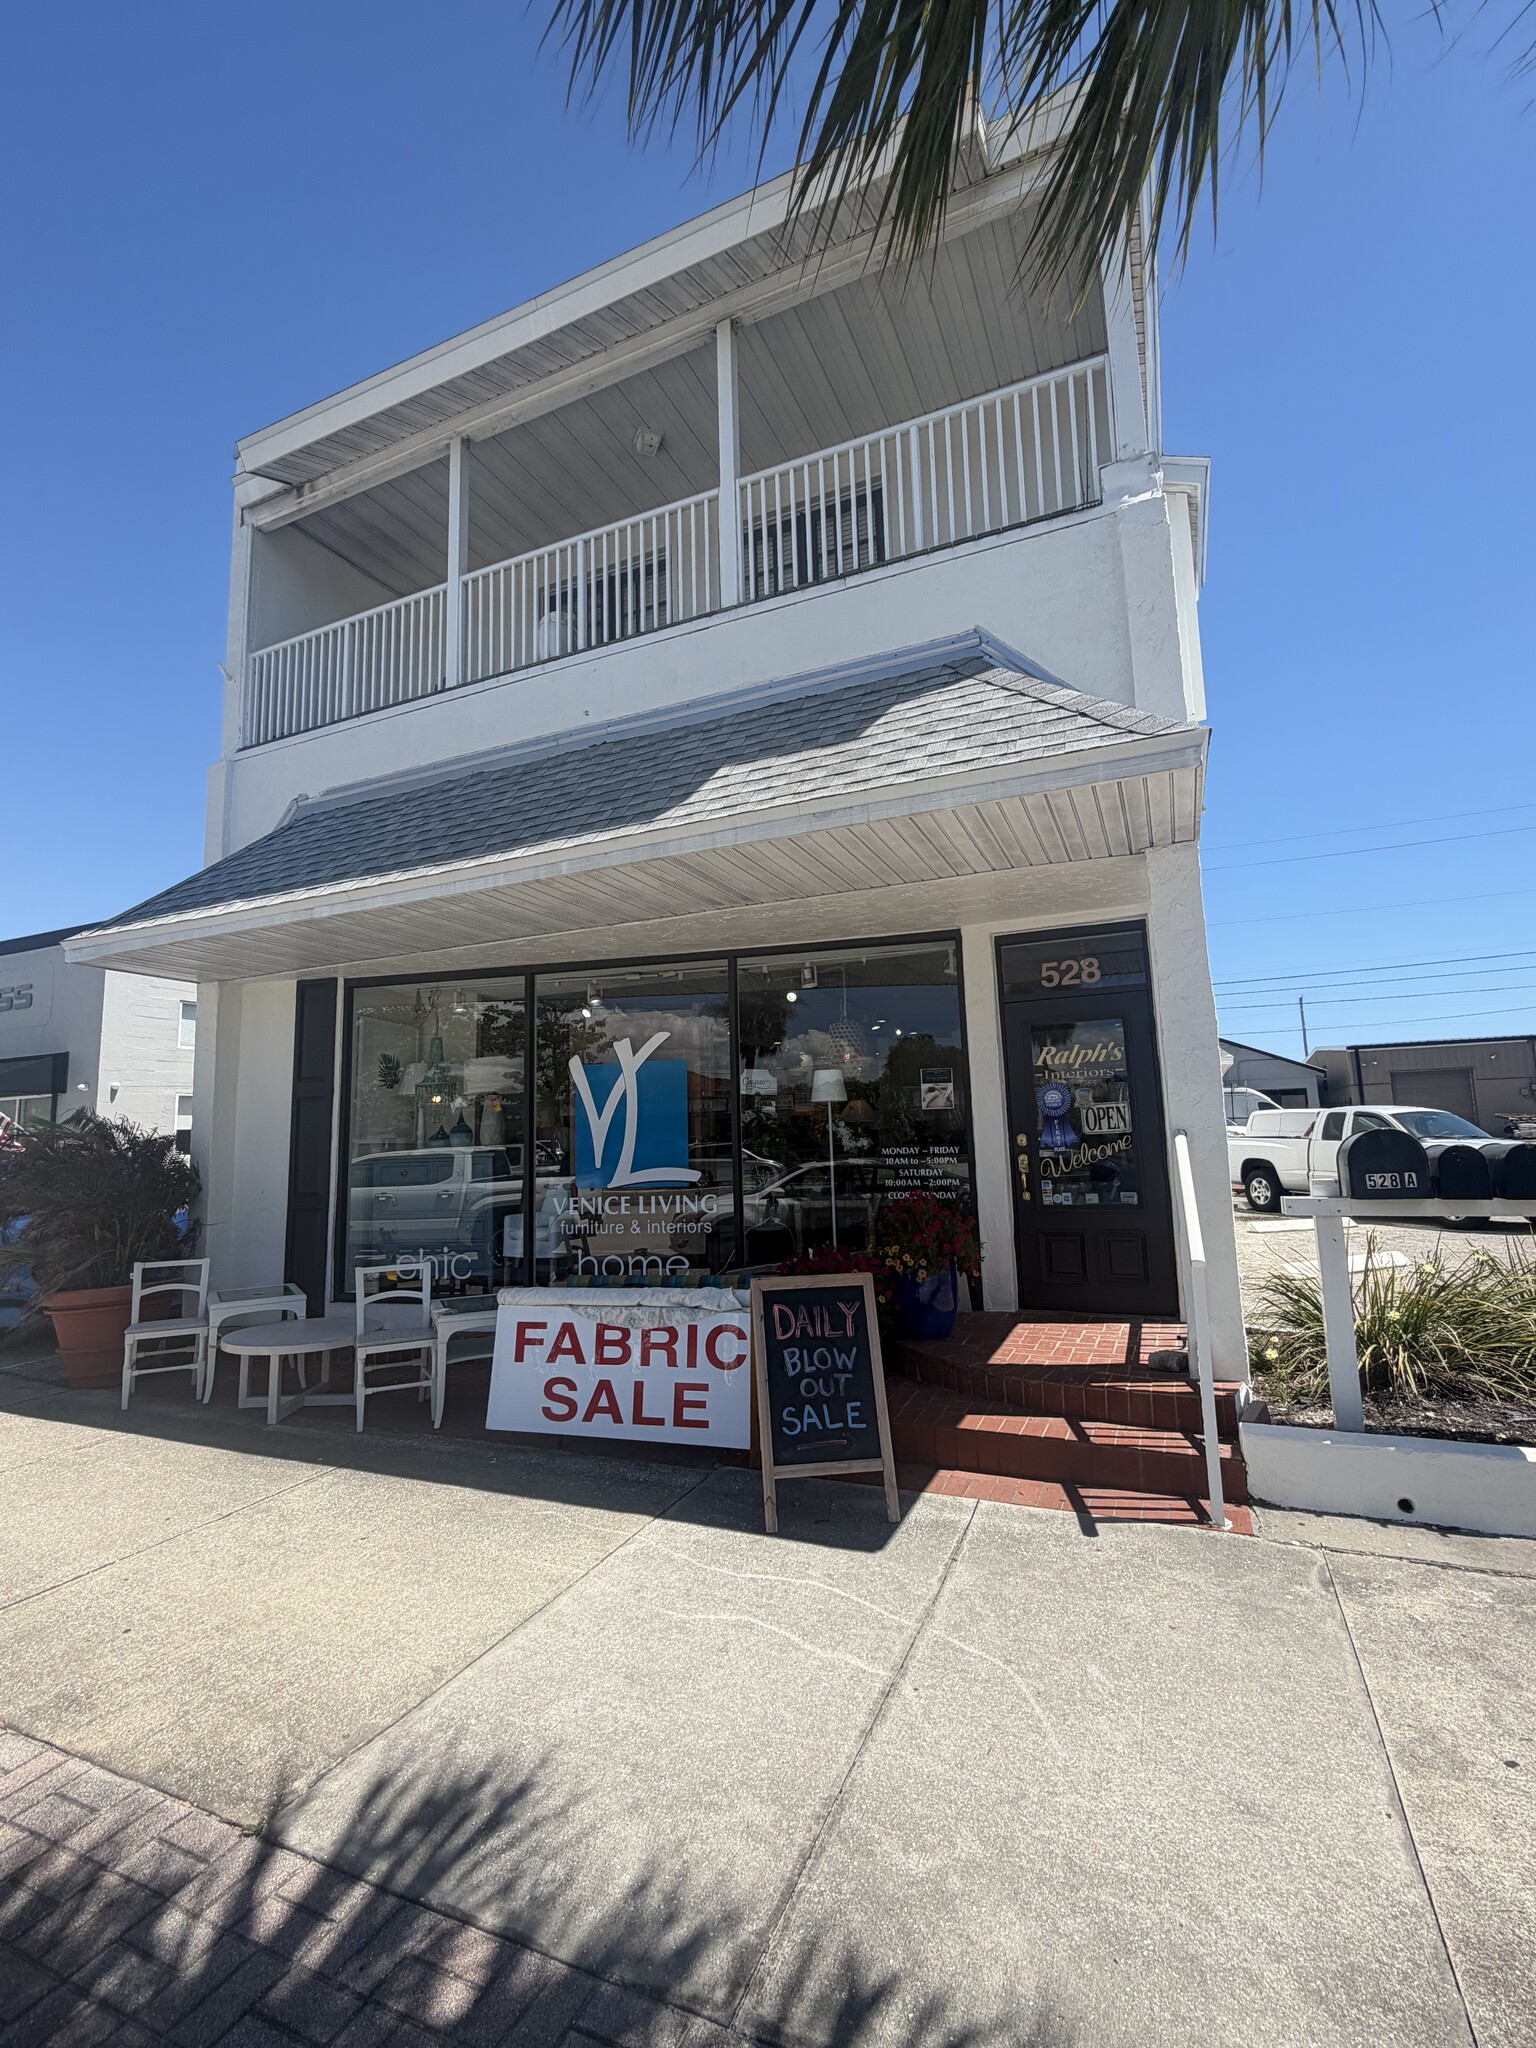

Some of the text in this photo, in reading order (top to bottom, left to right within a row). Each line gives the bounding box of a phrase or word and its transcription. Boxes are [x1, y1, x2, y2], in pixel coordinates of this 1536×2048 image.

[1040, 957, 1102, 988] 528
[1035, 1041, 1125, 1069] Ralph's
[1044, 1067, 1115, 1080] Interiors
[1085, 1105, 1128, 1131] OPEN
[881, 1146, 920, 1155] MONDAY
[929, 1146, 960, 1154] FRIDAY
[885, 1157, 908, 1165] 10AM
[910, 1157, 919, 1165] to
[1040, 1135, 1132, 1177] Welcome
[884, 1179, 921, 1187] 10:00AM
[898, 1168, 944, 1177] SATURDAY
[1368, 1173, 1416, 1188] 528 A
[552, 1194, 718, 1215] VENICE LIVING
[887, 1191, 919, 1200] CLOS
[559, 1219, 713, 1235] furniture & interiors
[577, 1248, 690, 1276] home
[772, 1300, 861, 1340] DAILY
[513, 1321, 748, 1371] FABRIC
[782, 1346, 857, 1377] BLOW
[799, 1373, 853, 1398] OUT
[541, 1376, 710, 1429] SALE
[781, 1401, 867, 1436] SALE
